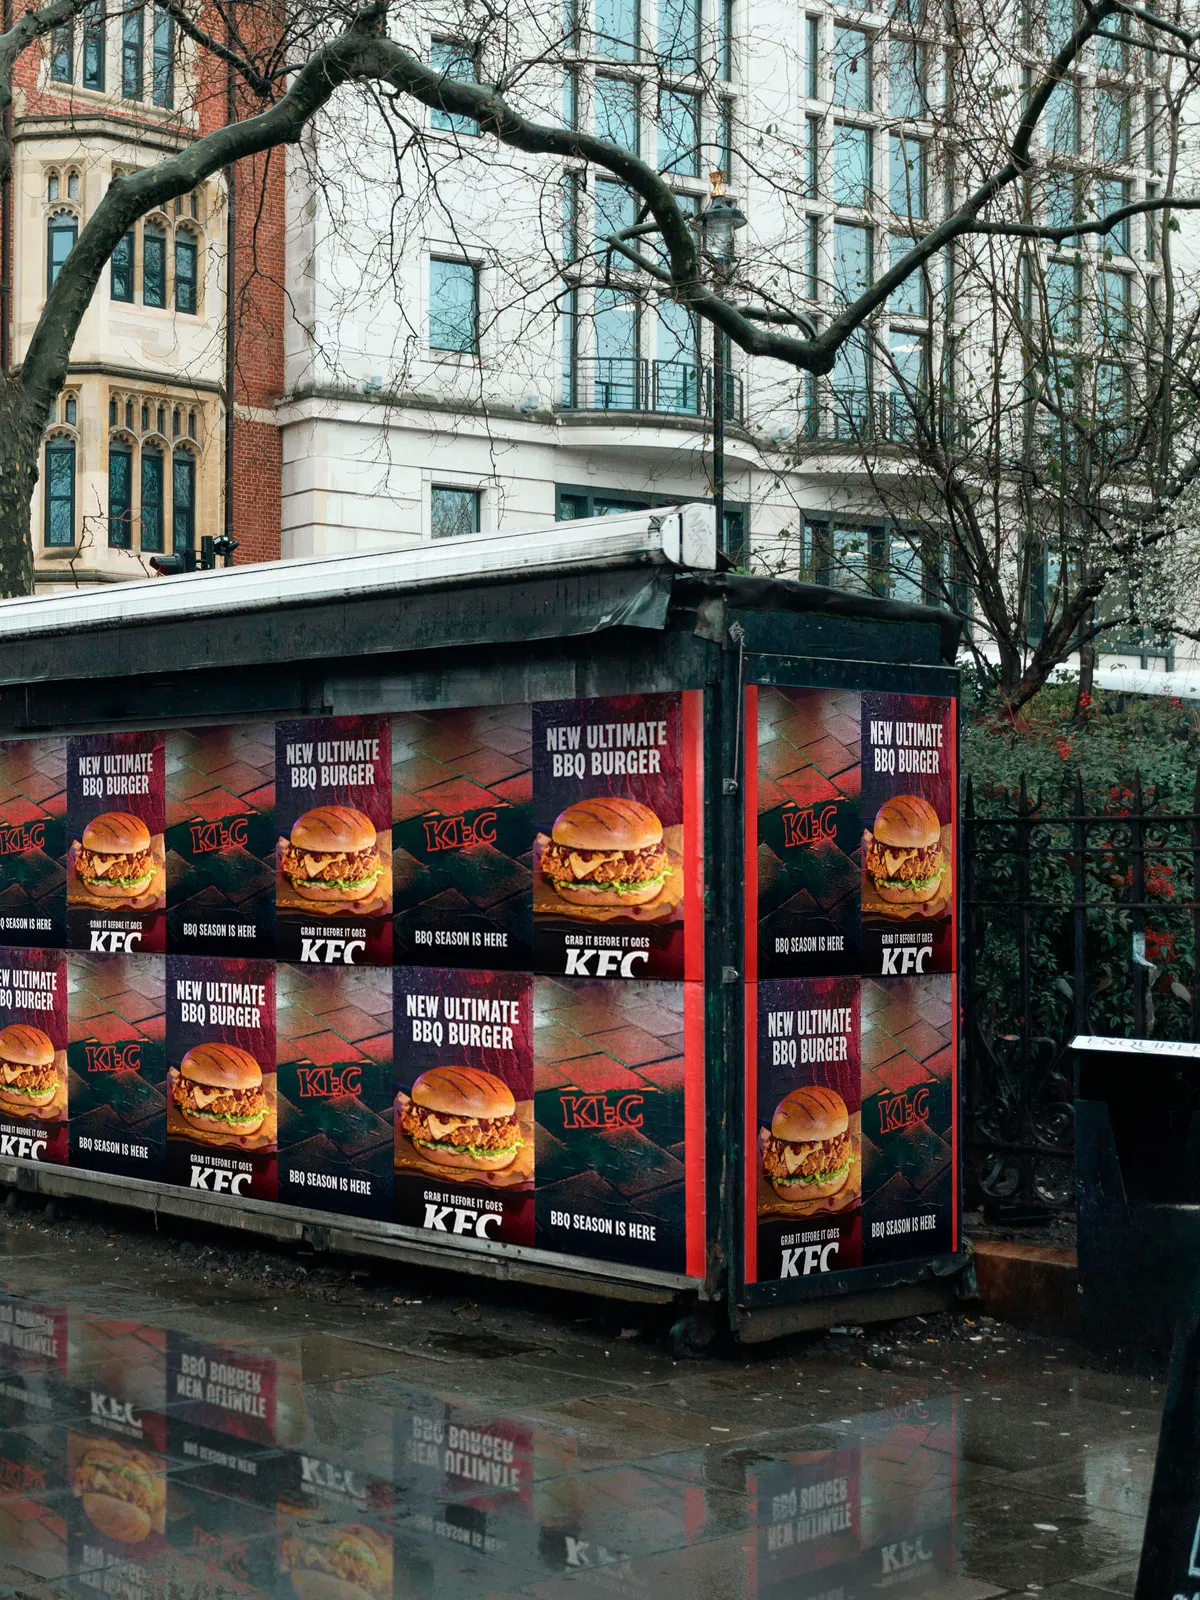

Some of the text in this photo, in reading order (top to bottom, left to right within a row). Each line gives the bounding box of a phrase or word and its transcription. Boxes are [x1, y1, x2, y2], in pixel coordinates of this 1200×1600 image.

[546, 720, 667, 751] NEW ULTIMATE
[870, 720, 943, 747] NEW ULTIMATE
[79, 752, 153, 776] NEW ULTIMATE
[286, 738, 380, 765] NEW ULTIMATE
[553, 748, 660, 781] BBQ BURGER
[874, 748, 939, 776] BBQ BURGER
[83, 774, 149, 799] BBQ BURGER
[291, 763, 374, 791] BBQ BURGER
[5, 917, 27, 929] SEASON
[29, 918, 35, 929] IS
[36, 918, 51, 930] HERE
[183, 923, 256, 938] BBQ SEASON IS HERE
[300, 927, 366, 937] GRAB IT BEFORE IT GOES
[90, 931, 141, 953] KFC
[300, 939, 365, 964] KFC
[415, 930, 507, 947] BBQ SEASON IS HERE
[565, 935, 649, 948] GRAB IT BEFORE IT GOES
[775, 936, 844, 955] BBQ SEASON IS HERE
[881, 933, 932, 944] GRAB IT BEFORE IT GOES
[564, 948, 648, 978] KFC
[881, 946, 932, 975] KFC
[12, 969, 57, 991] ULTIMATE
[176, 979, 265, 1006] NEW ULTIMATE
[15, 990, 53, 1011] BURGER
[406, 994, 519, 1024] NEW ULTIMATE
[181, 1002, 260, 1028] BBQ BURGER
[768, 1007, 852, 1038] NEW ULTIMATE
[412, 1019, 513, 1050] BBQ BURGER
[772, 1035, 847, 1070] BBQ BURGER
[0, 1134, 47, 1161] KFC
[79, 1136, 148, 1159] BBQ SEASON IS HERE
[190, 1154, 252, 1172] GRAB IT BEFORE IT GOES
[190, 1165, 252, 1196] KFC
[289, 1169, 371, 1195] BBQ SEASON IS HERE
[423, 1190, 503, 1212] GRAB IT BEFORE IT GOES
[423, 1203, 502, 1239] KFC
[551, 1210, 656, 1241] BBQ SEASON IS HERE
[871, 1214, 936, 1240] BBQ SEASON IS HERE
[780, 1227, 839, 1246] GRAB IT BEFORE IT GOES
[780, 1241, 839, 1278] KFC
